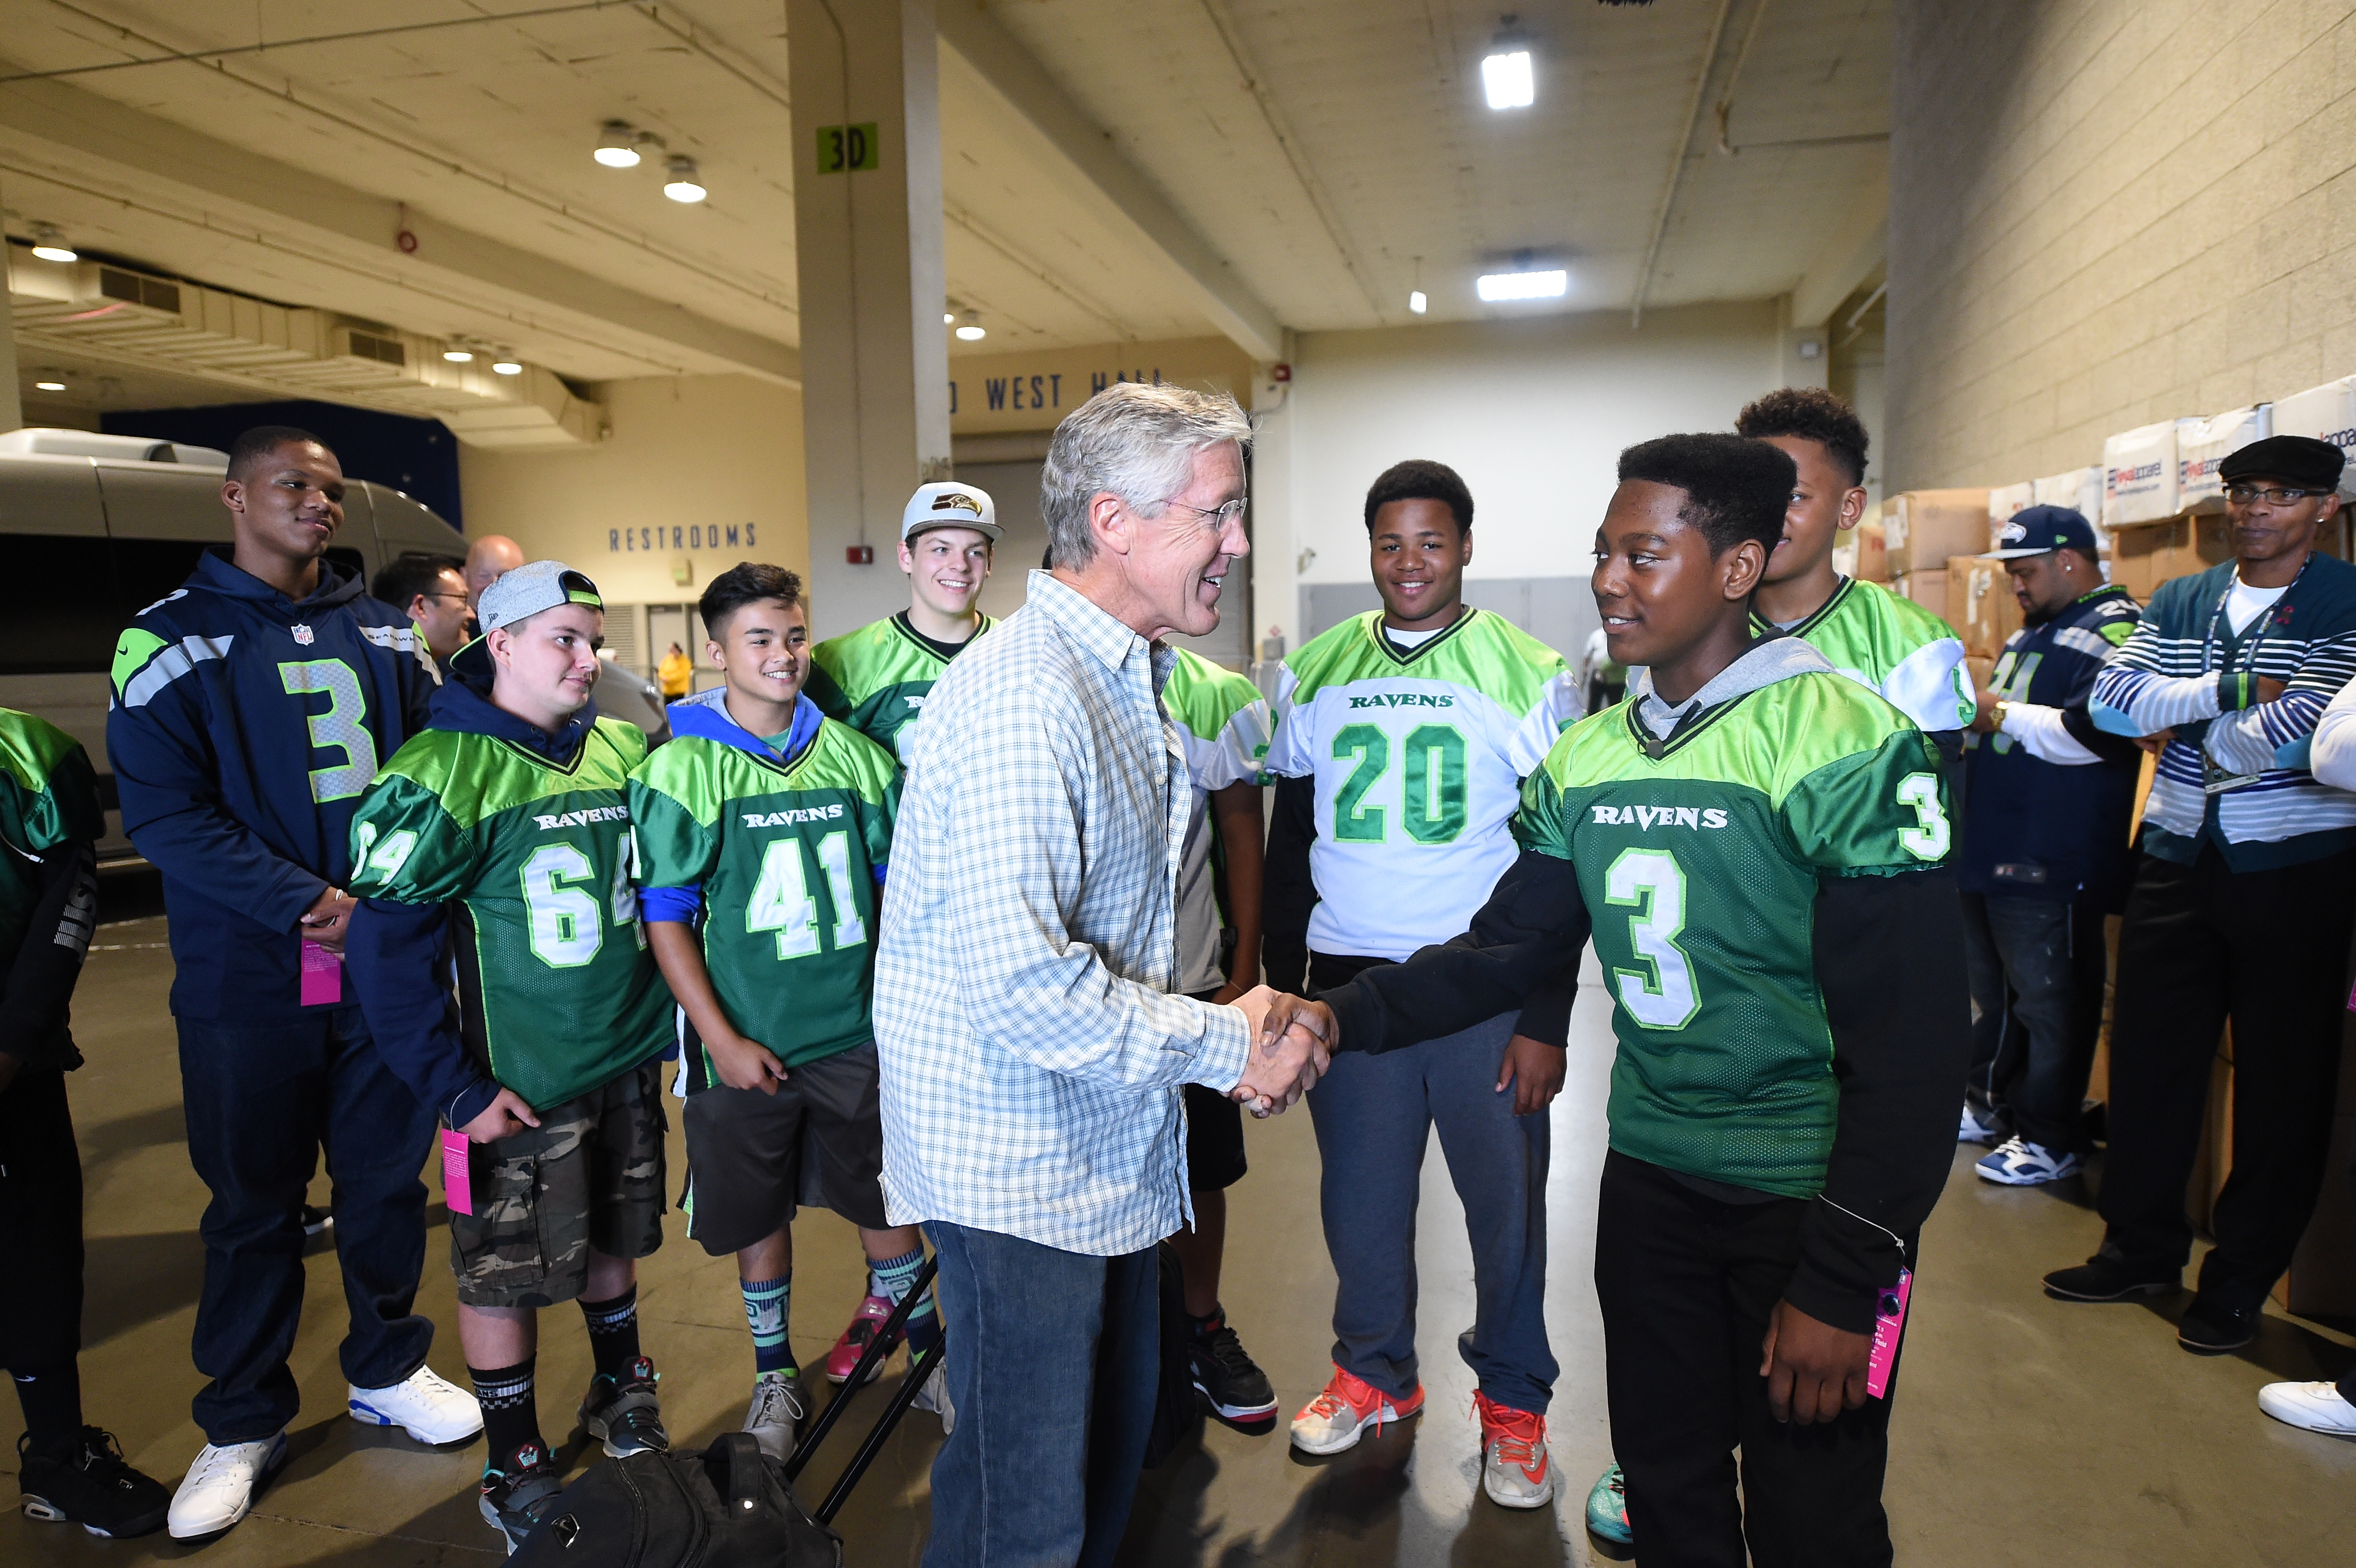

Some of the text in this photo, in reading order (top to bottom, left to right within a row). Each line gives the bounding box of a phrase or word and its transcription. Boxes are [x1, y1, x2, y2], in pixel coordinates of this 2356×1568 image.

[830, 128, 865, 170] 3D
[985, 374, 1061, 410] WEST
[609, 522, 755, 552] RESTROOMS
[297, 632, 312, 641] NFL
[1348, 693, 1455, 709] RAVENS
[277, 658, 378, 804] 3
[1331, 722, 1469, 845] 20
[532, 805, 629, 831] RAVENS
[741, 804, 843, 828] RAVENS
[1591, 805, 1728, 832] RAVENS
[1897, 772, 1951, 861] 3
[745, 830, 867, 961] 41
[1604, 847, 1703, 1031] 3
[477, 1387, 499, 1398] ANS
